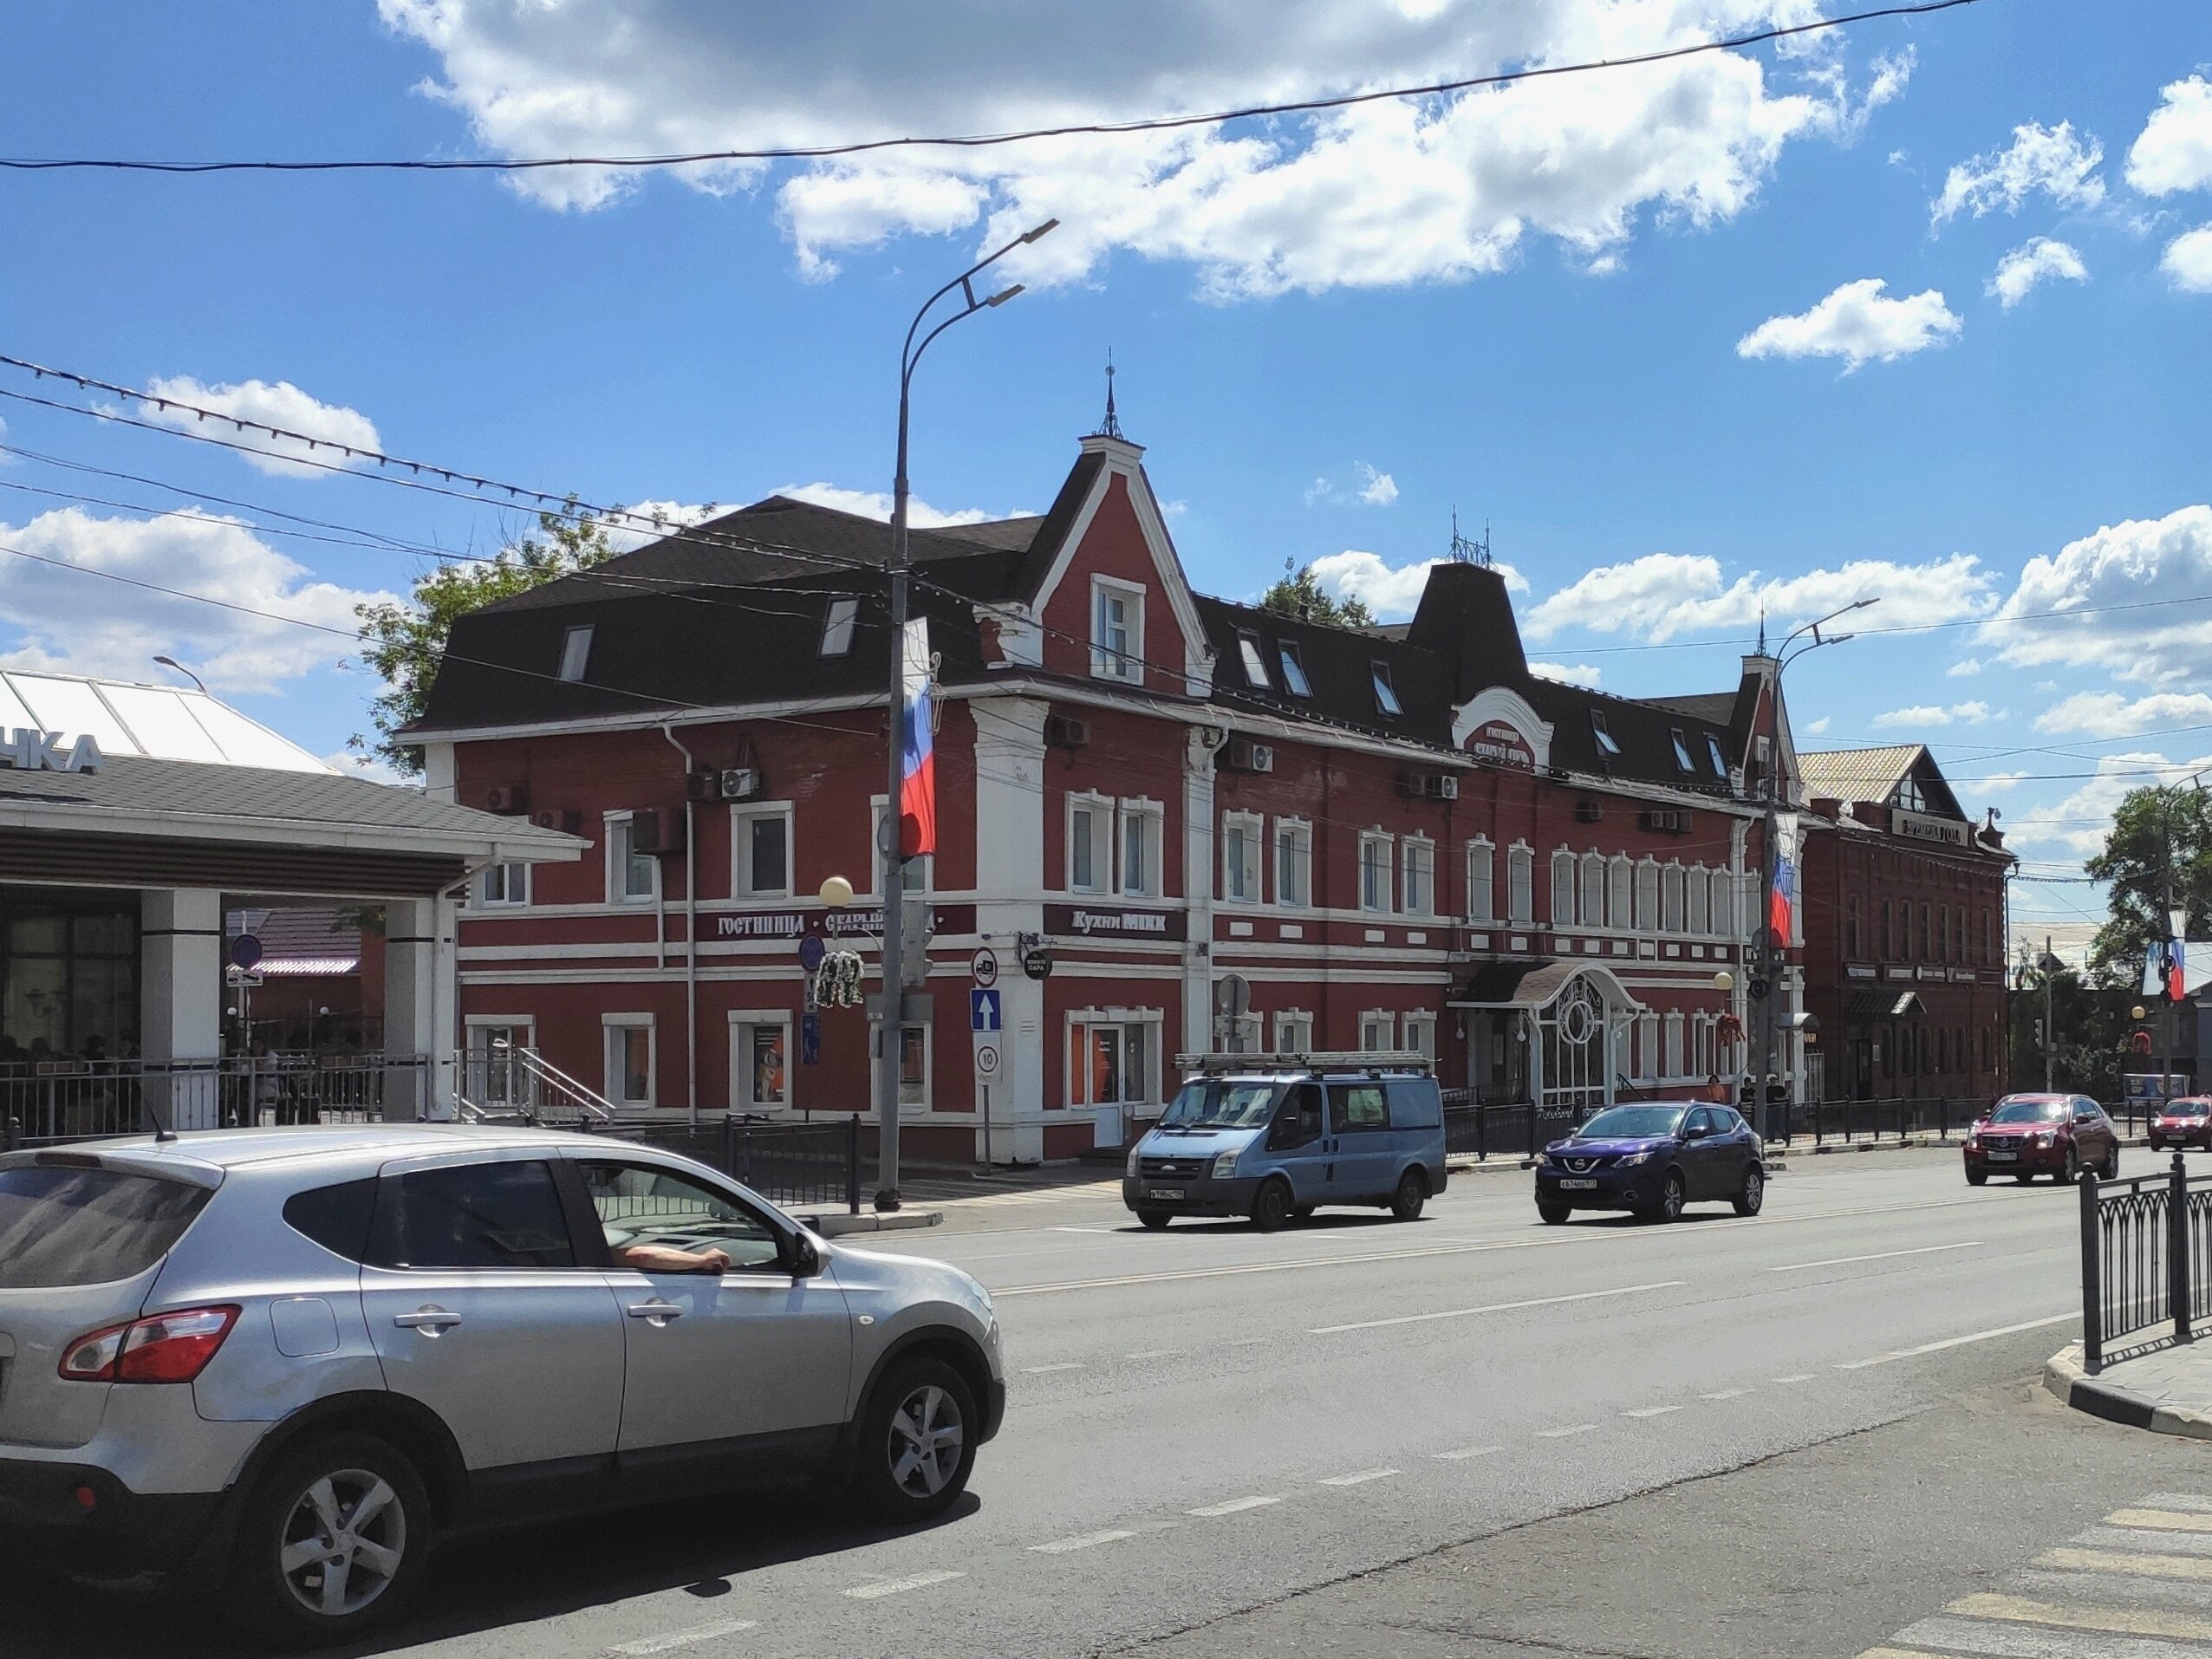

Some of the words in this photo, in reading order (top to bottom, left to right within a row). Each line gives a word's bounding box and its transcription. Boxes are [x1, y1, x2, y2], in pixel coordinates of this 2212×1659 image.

[718, 915, 805, 938] ГОСТИНИЦА
[1071, 911, 1120, 934] Кухни
[983, 1053, 992, 1064] 10
